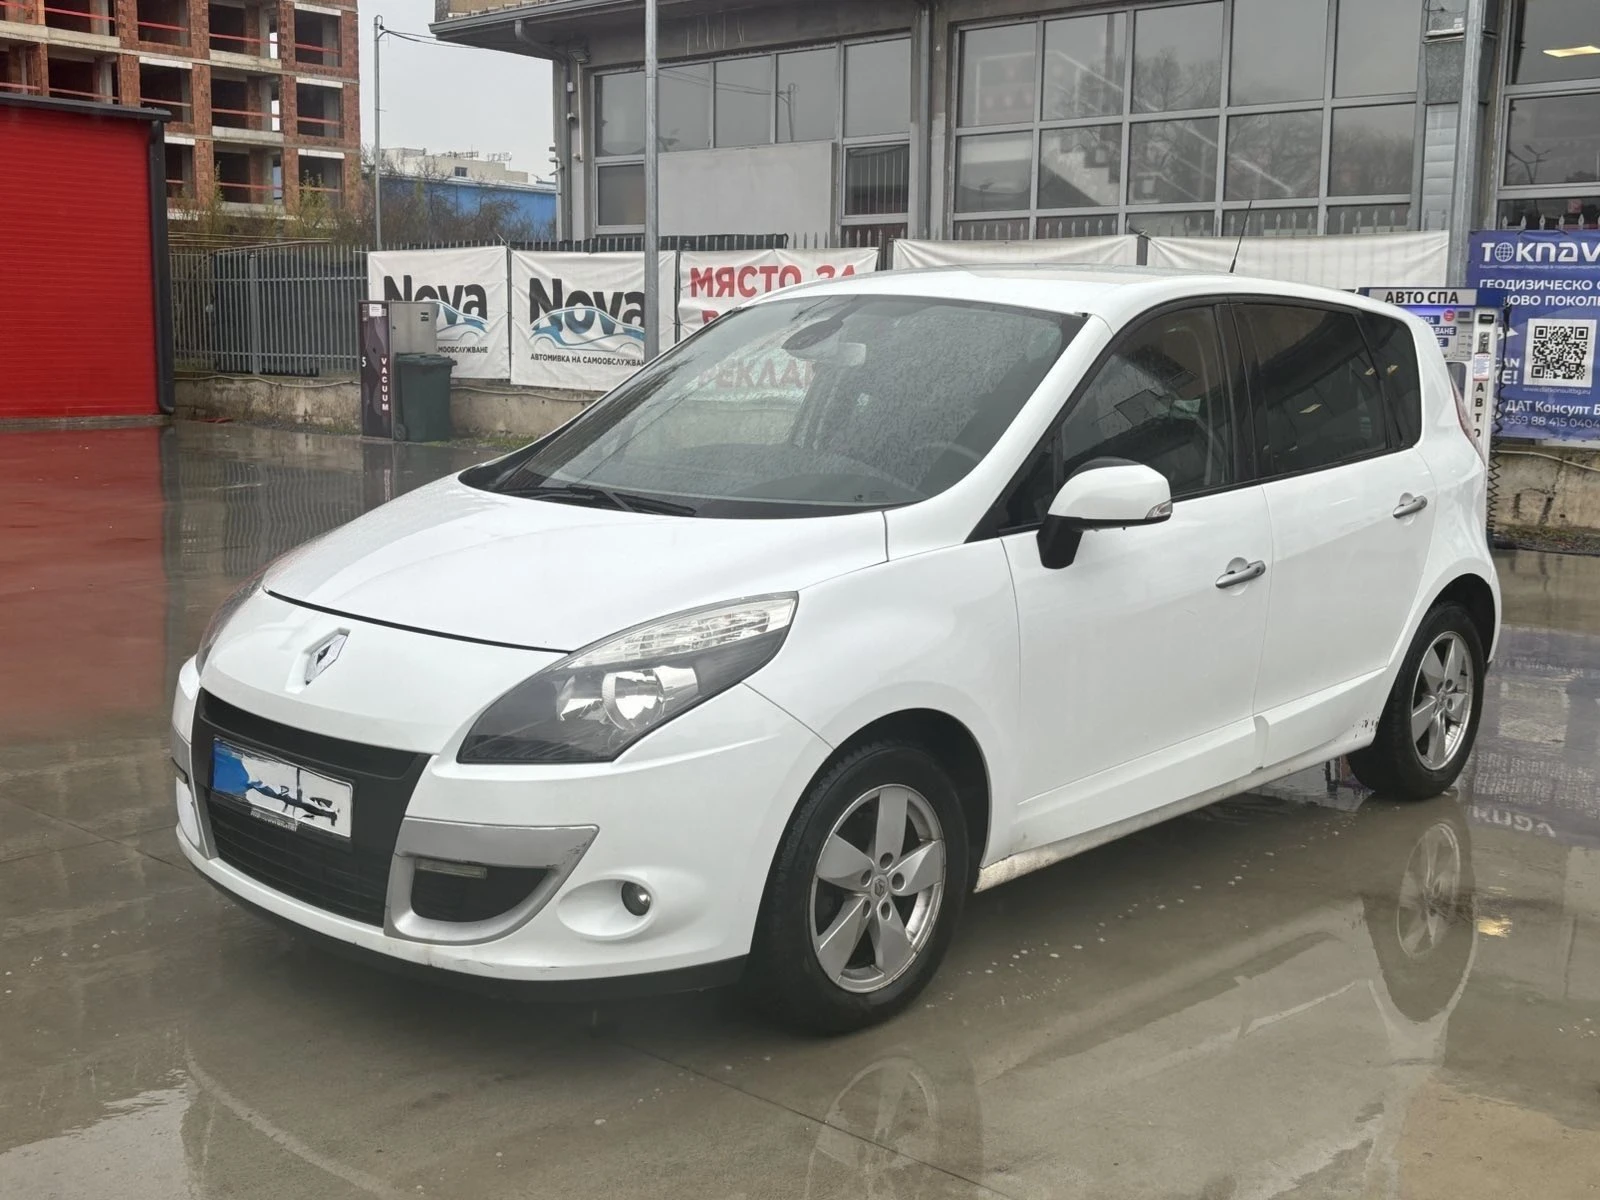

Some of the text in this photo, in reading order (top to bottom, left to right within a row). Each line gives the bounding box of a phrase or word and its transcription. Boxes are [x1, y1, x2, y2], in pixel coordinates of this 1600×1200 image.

[690, 265, 802, 297] МЯСТО
[1480, 279, 1593, 291] ГЕОДИЗИЧЕСКО
[1385, 291, 1459, 304] АВТО СПА
[529, 278, 645, 335] Nova
[438, 346, 488, 354] МООБСЛУЖВАНЕ
[530, 353, 570, 363] АВТОМИВКА
[583, 356, 645, 367] САМООБСЛУЖВАН
[381, 357, 389, 411] VACUUM
[1505, 400, 1533, 413] ДАТ
[1535, 401, 1591, 417] Консулт
[1531, 416, 1546, 426] 88
[1549, 417, 1567, 427] 415
[1569, 418, 1600, 428] 0404
